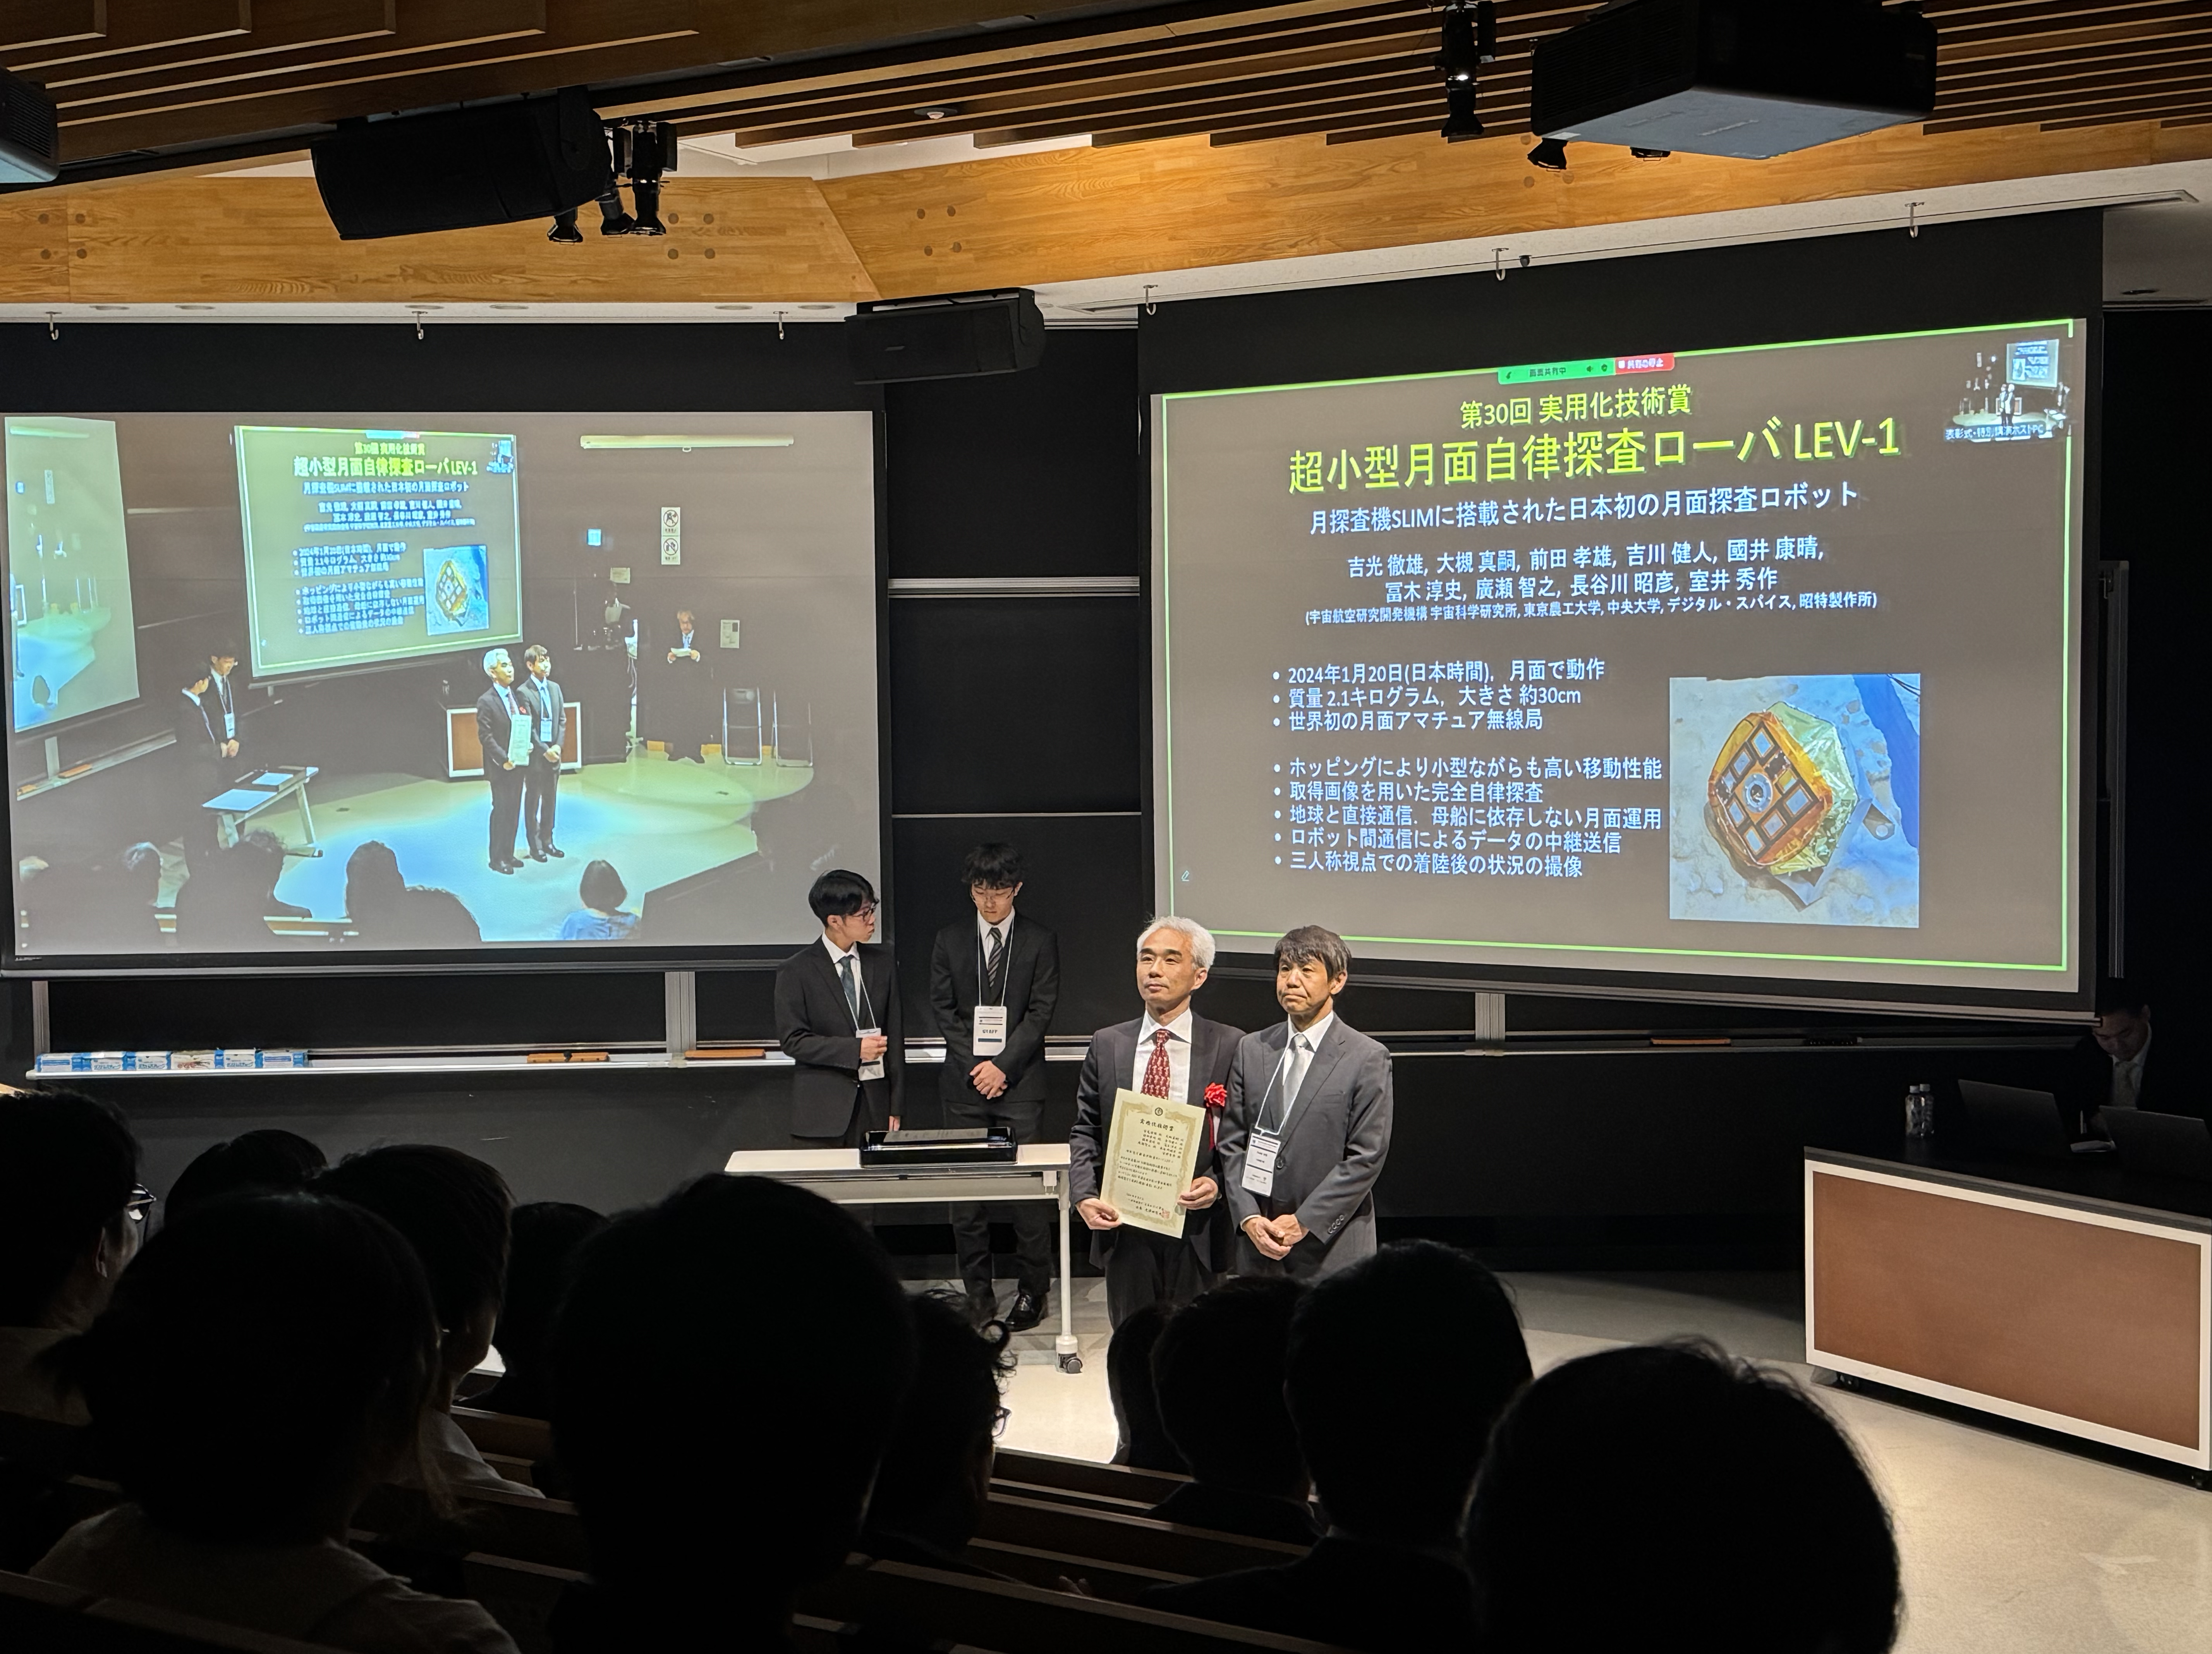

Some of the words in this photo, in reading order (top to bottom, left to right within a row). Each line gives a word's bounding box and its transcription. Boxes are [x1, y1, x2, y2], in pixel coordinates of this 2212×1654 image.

[1460, 397, 1531, 429] 第30回
[1539, 384, 1691, 423] 実用化技術賞
[1289, 416, 1781, 494] 超小型月面自律探査ローバ
[1794, 418, 1899, 460] LEV-1
[1311, 481, 1857, 535] 月探査機SLIMに搭載された日本初の月面探査ロボット
[1347, 555, 1383, 578] 吉光
[1529, 548, 1566, 571] 前田
[1626, 543, 1665, 566] 吉川
[1672, 540, 1717, 565] 健人,
[1728, 538, 1770, 563] 國井
[1570, 573, 1627, 597] 長谷川
[1689, 569, 1730, 592] 室井
[1736, 566, 1778, 590] 秀作
[1510, 657, 1605, 681] 月面で動作
[1289, 687, 1323, 709] 質量
[1458, 685, 1512, 706] 大きさ
[1519, 684, 1581, 706] 約30cm
[1289, 708, 1543, 731] 世界初の月面アマチュア無線局
[1290, 756, 1662, 780] ホッピングにより小型ながらも高い移動性能
[1290, 781, 1543, 803] 取得画像を用いた完全自律探査
[1431, 805, 1661, 829] 母船に依存しない月面運用
[1292, 827, 1622, 853] ロボット間通信によるデータの中継送信
[1290, 851, 1583, 877] 三人称視点での着陸後の状況の撮像
